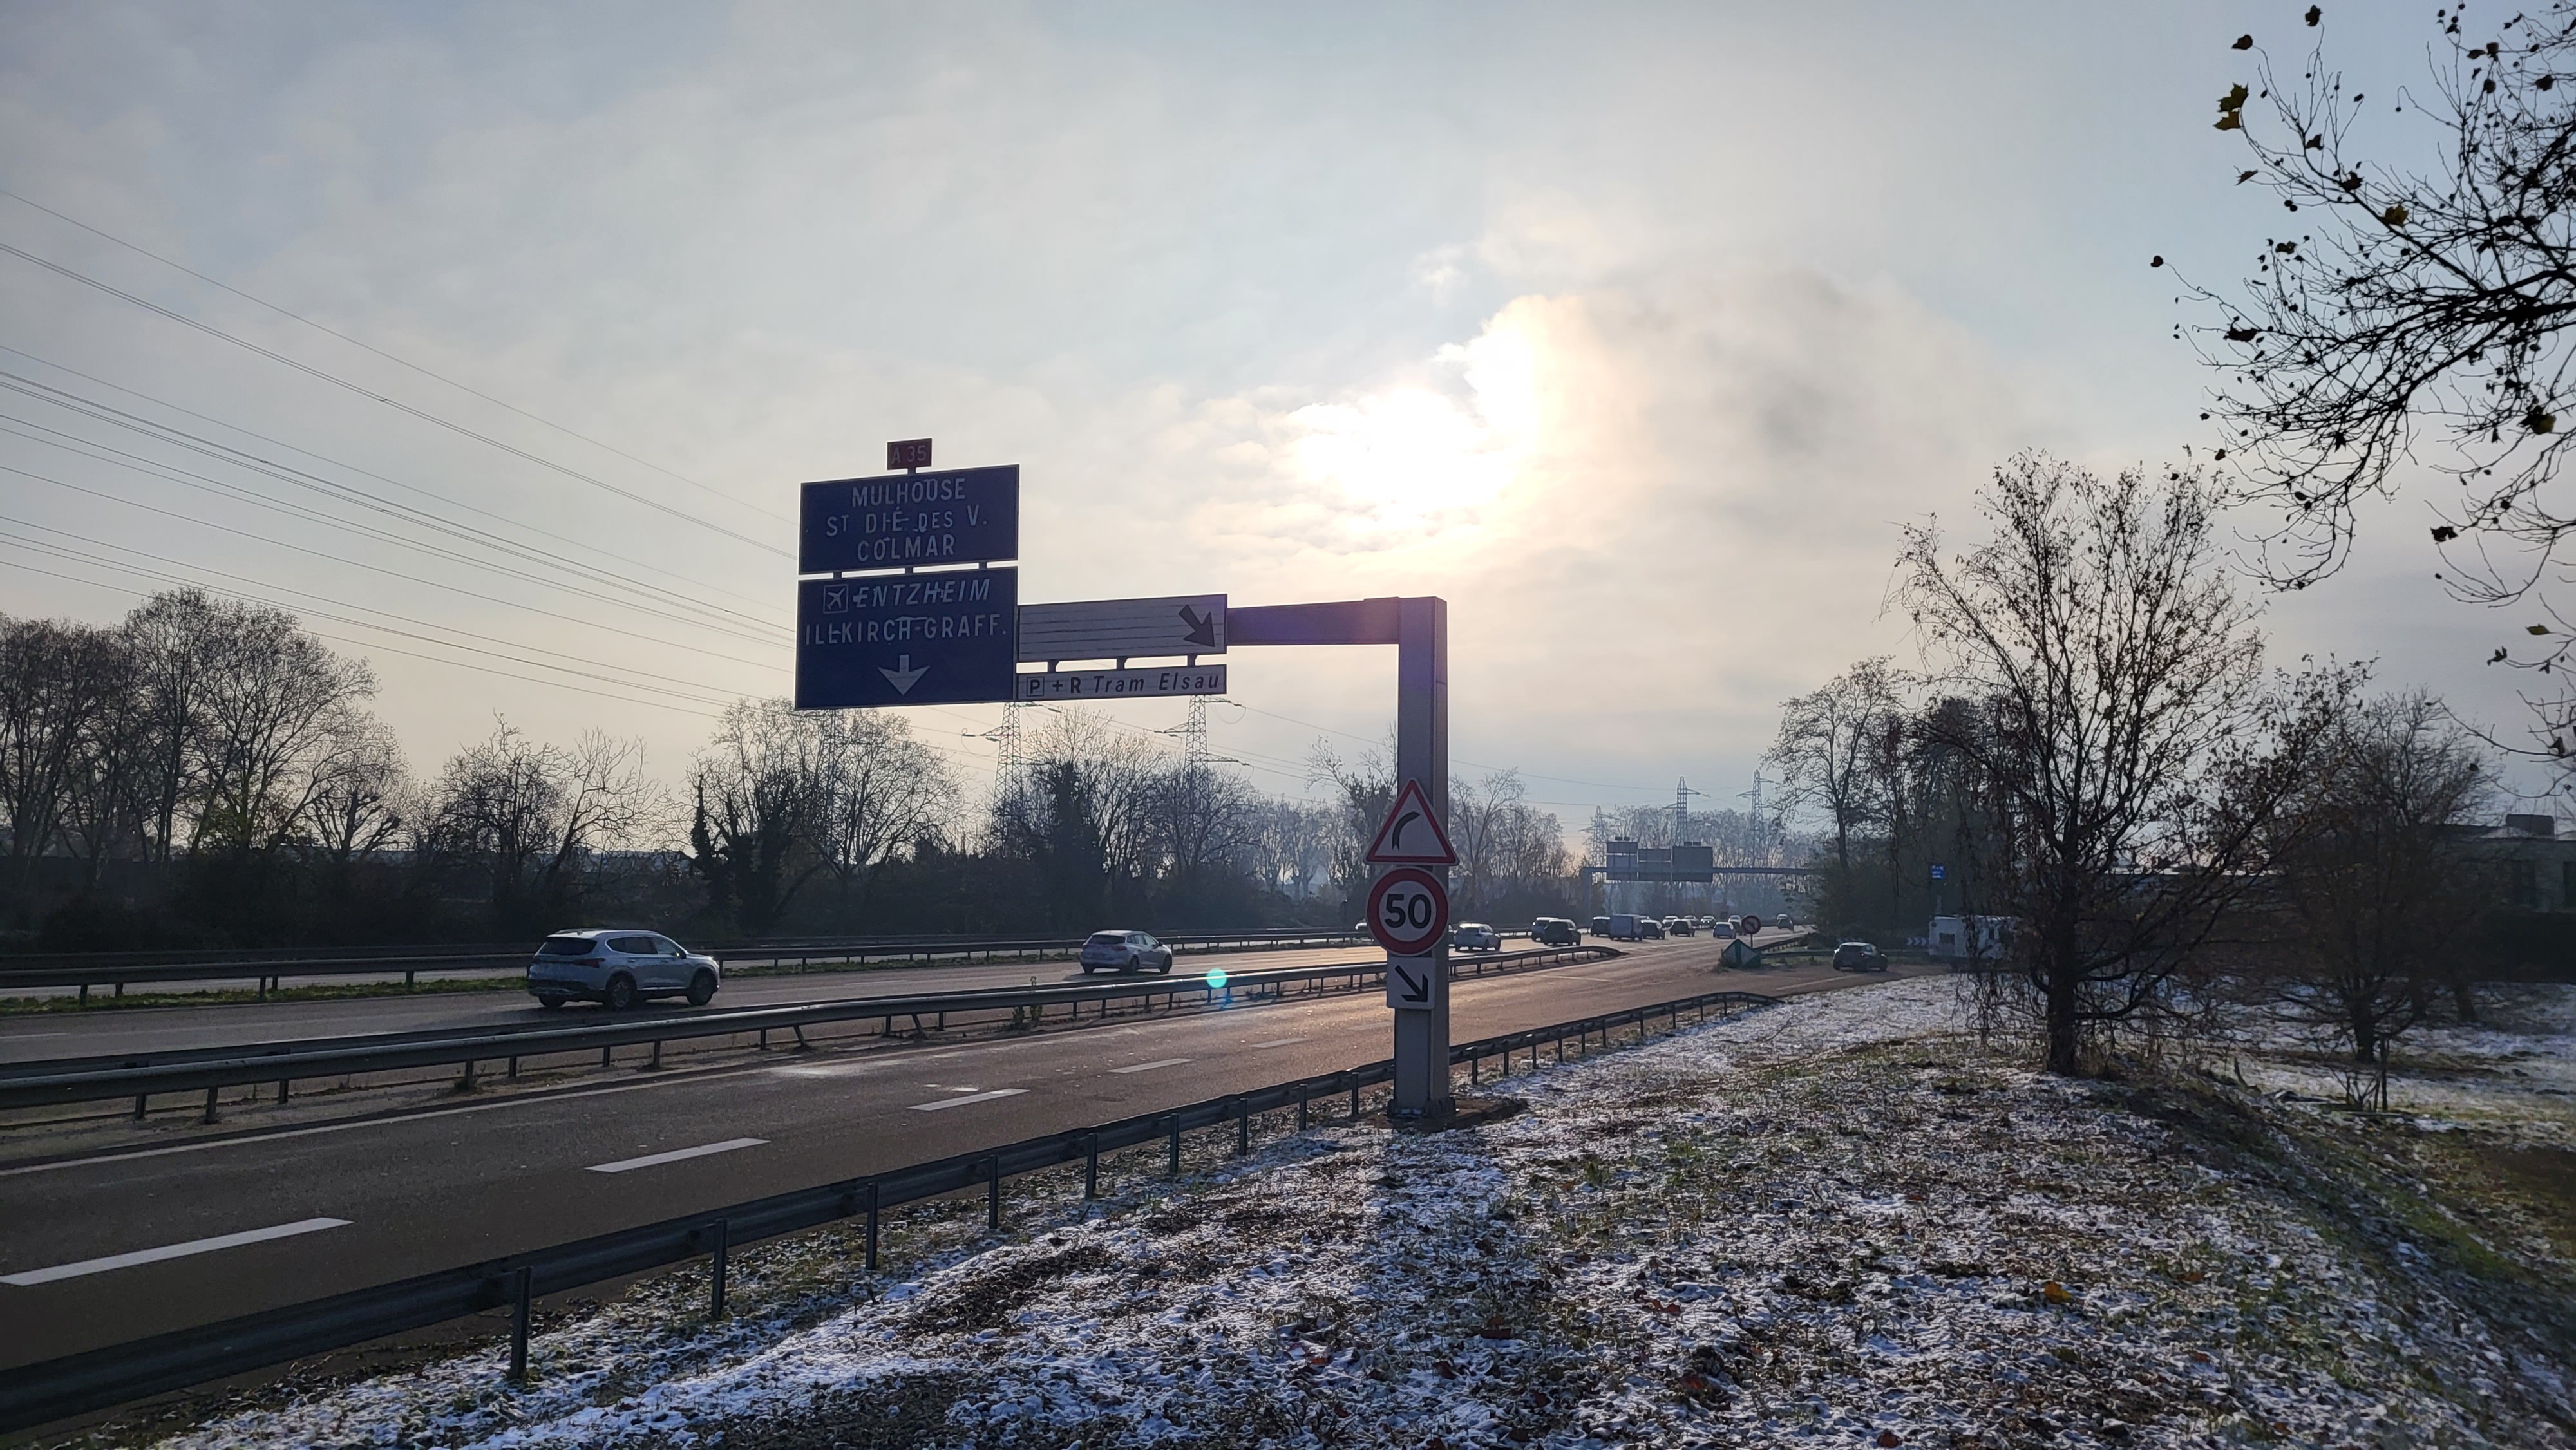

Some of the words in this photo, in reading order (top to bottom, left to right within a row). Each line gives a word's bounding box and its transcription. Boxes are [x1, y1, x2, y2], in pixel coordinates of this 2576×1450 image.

[891, 447, 900, 462] A
[907, 445, 926, 462] 35
[852, 478, 966, 507] MULHOUSE
[918, 511, 953, 529] DES
[857, 534, 954, 561] COLMAR
[856, 579, 990, 607] ENTZHEIM
[805, 614, 1007, 645] ILLKIRCH-GRAFF.
[1094, 675, 1144, 692] Tram
[1159, 672, 1218, 690] Elsau
[1385, 894, 1432, 929] 50
